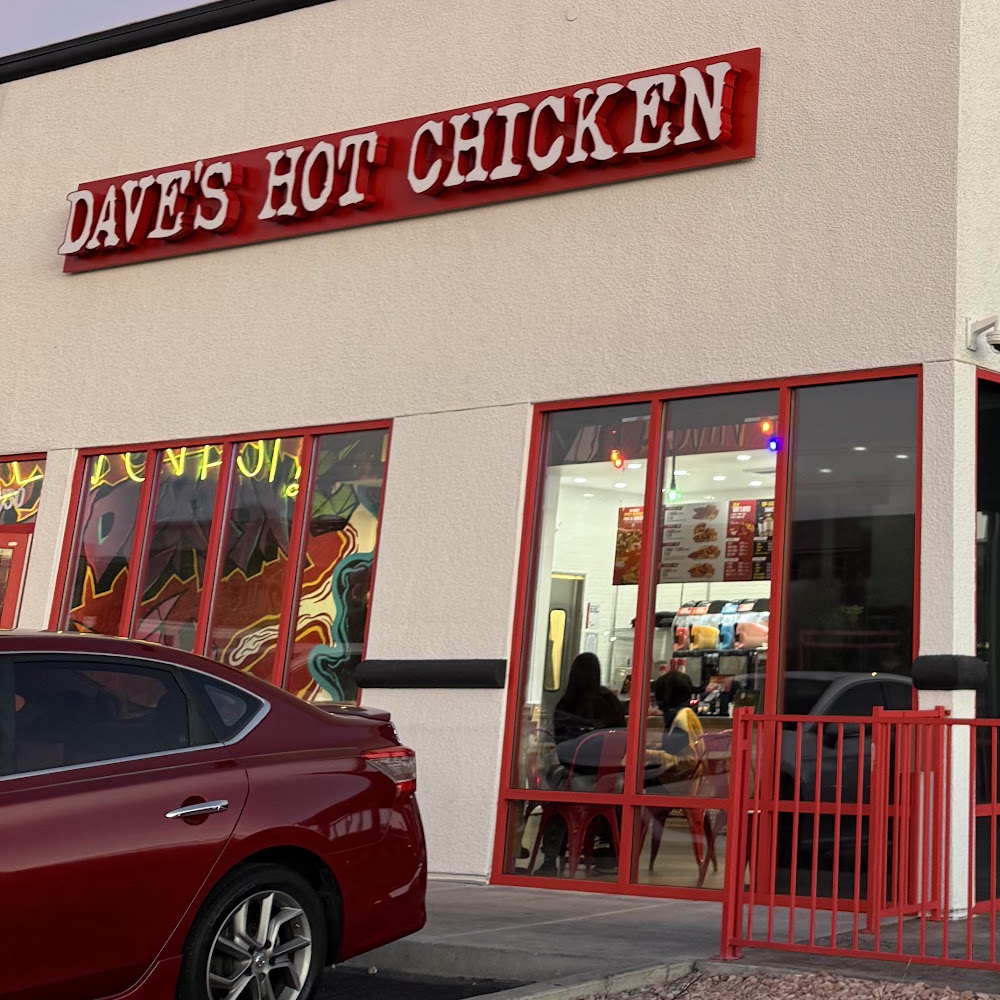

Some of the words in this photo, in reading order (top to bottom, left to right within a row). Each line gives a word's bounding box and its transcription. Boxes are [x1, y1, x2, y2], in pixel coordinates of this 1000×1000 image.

[58, 160, 234, 256] DAVE'S
[260, 131, 380, 219] HOT
[406, 61, 733, 195] CHICKEN
